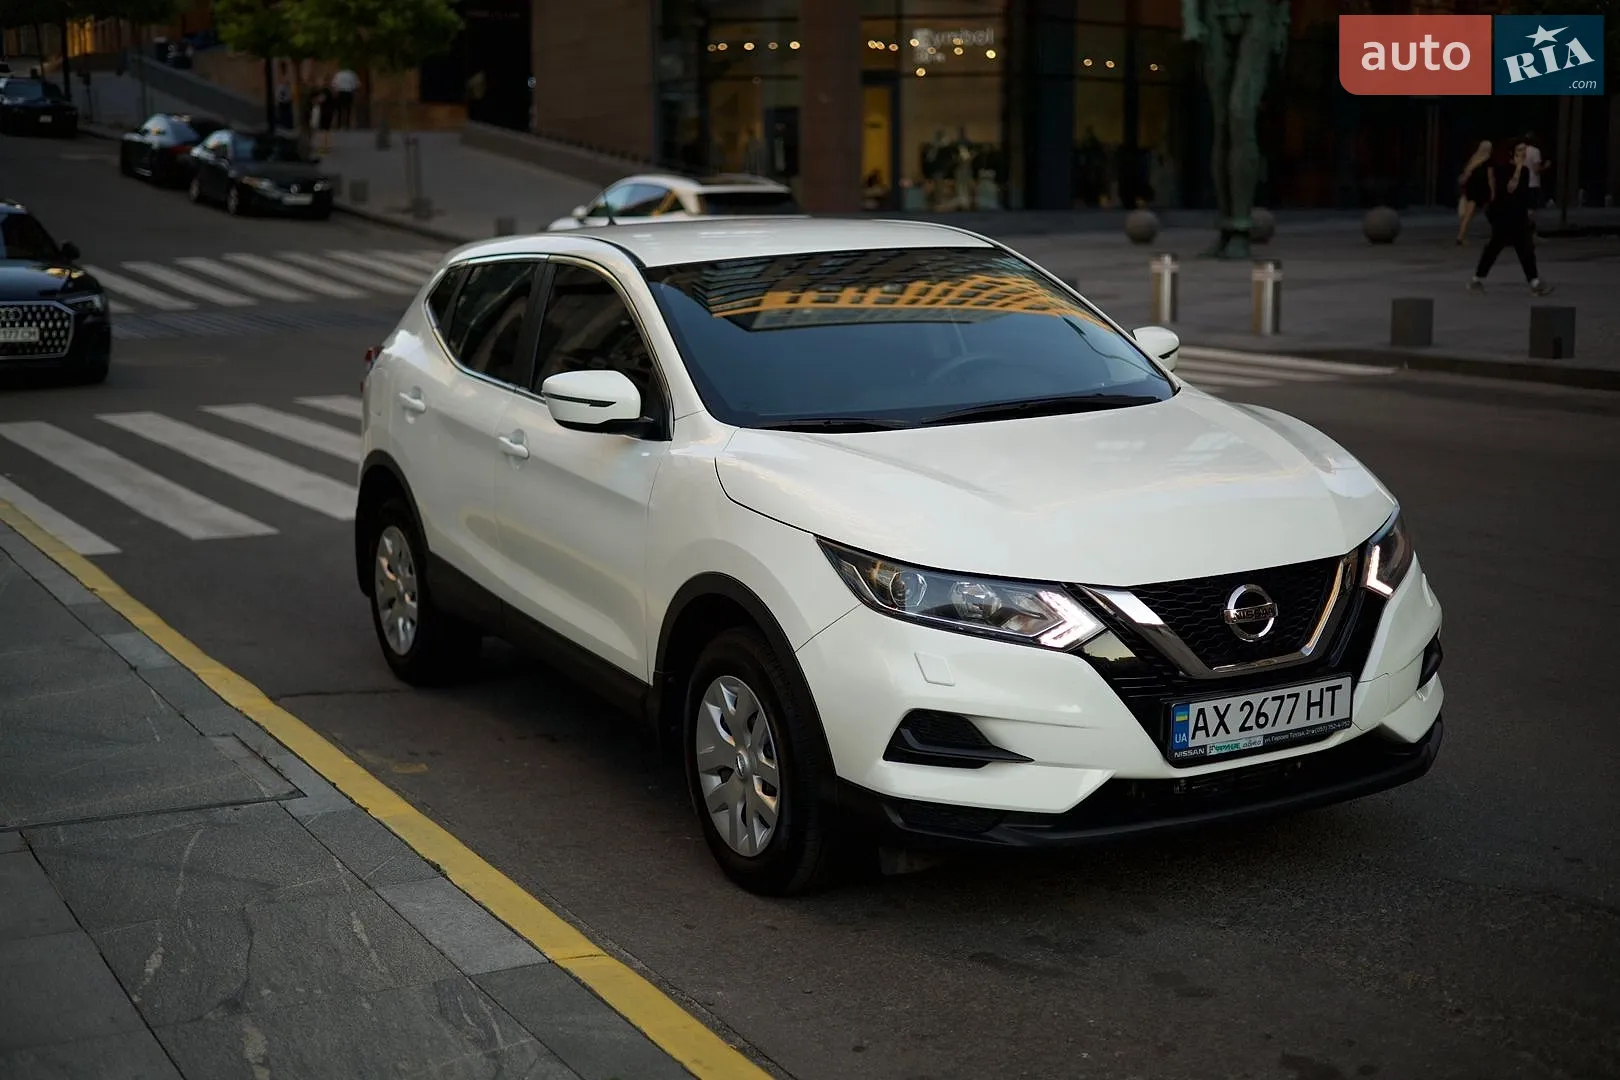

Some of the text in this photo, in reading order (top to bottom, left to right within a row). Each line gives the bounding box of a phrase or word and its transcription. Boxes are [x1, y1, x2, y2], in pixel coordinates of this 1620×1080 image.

[1191, 703, 1232, 740] AX
[1239, 692, 1301, 733] 2677
[1306, 684, 1343, 721] HT
[1174, 733, 1188, 743] UA
[1174, 747, 1205, 758] NISSAN
